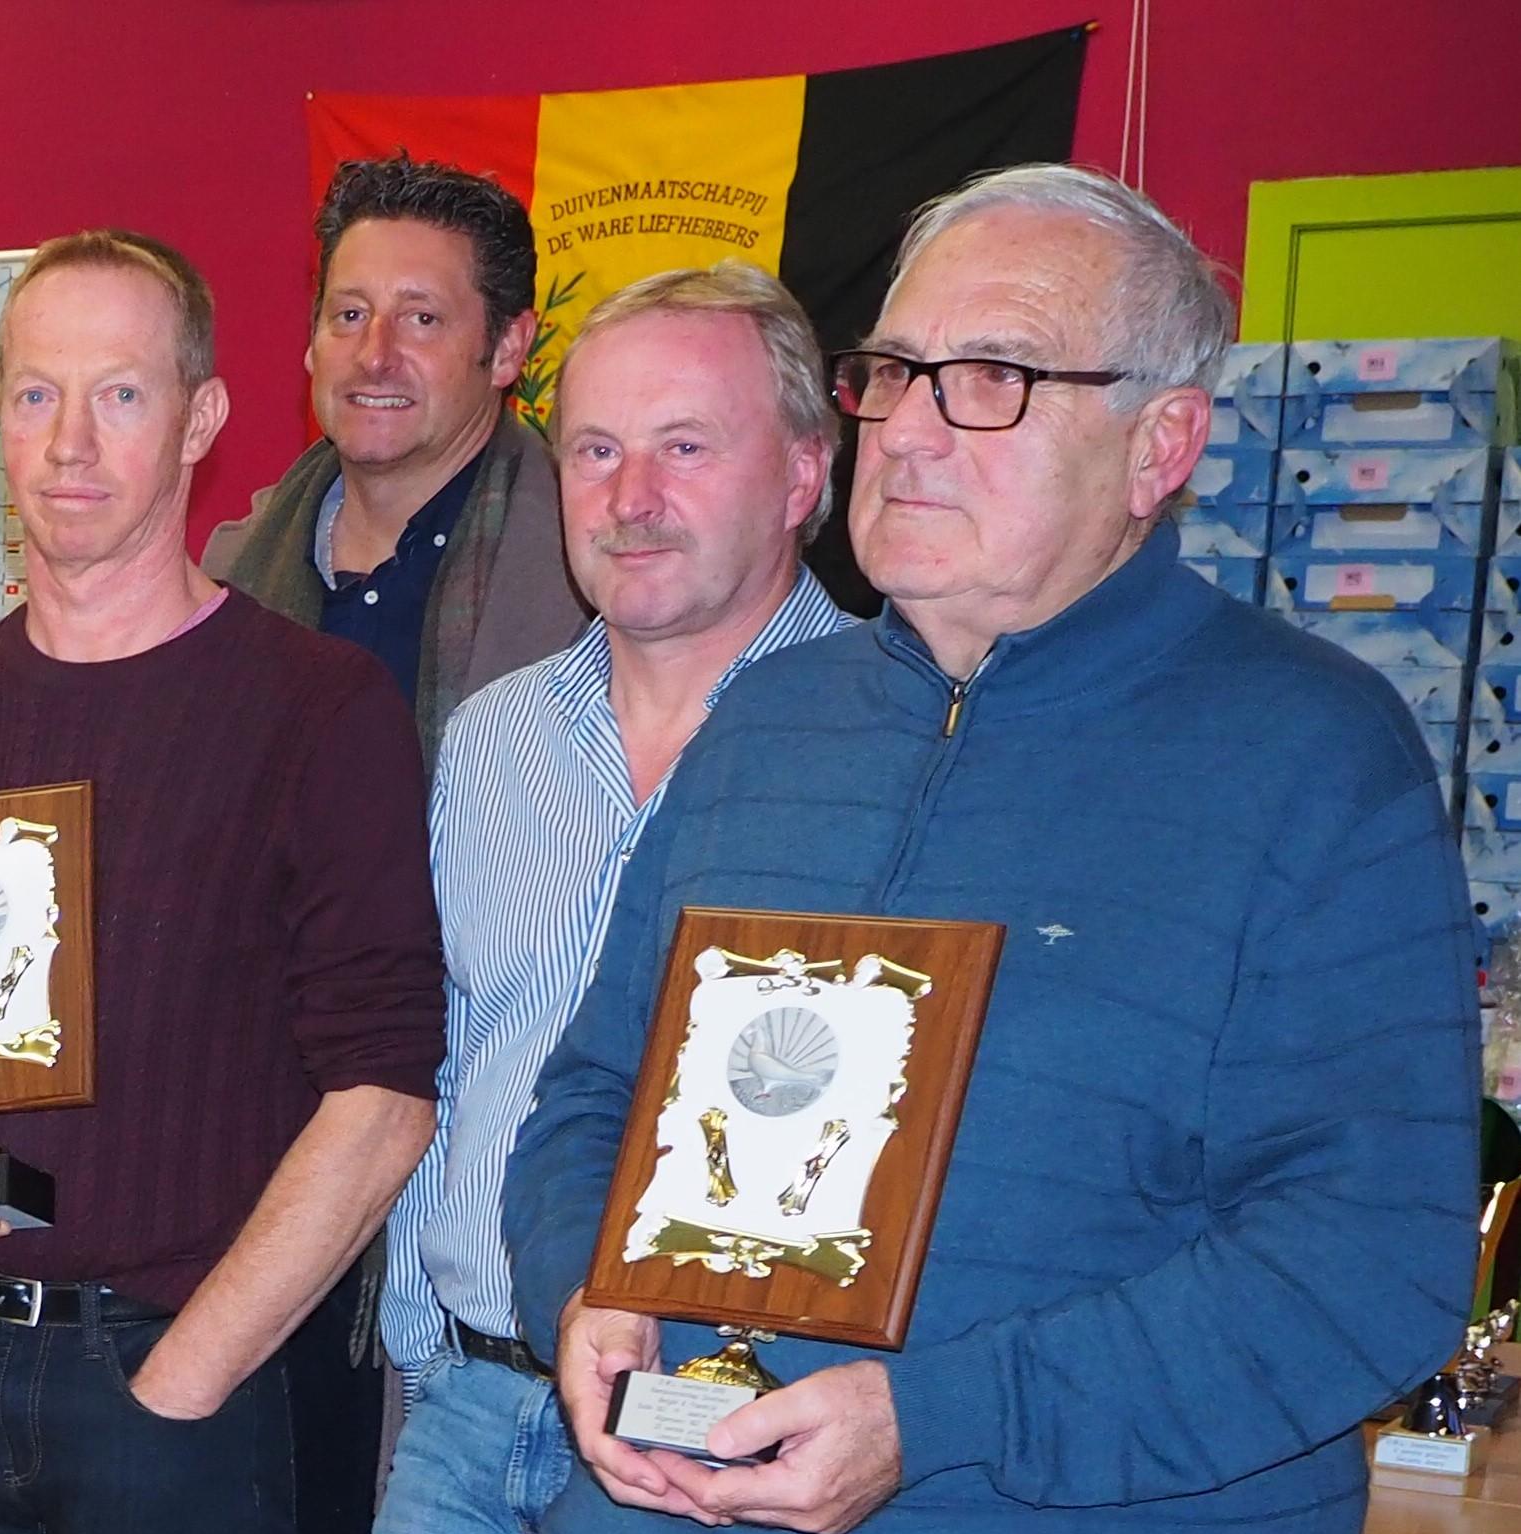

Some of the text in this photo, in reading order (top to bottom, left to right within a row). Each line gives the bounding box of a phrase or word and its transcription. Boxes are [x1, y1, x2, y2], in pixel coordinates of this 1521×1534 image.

[550, 180, 768, 221] DUIVENMAATSCHAPPIJ
[547, 214, 759, 255] DE WARE LIEFHEBBERS
